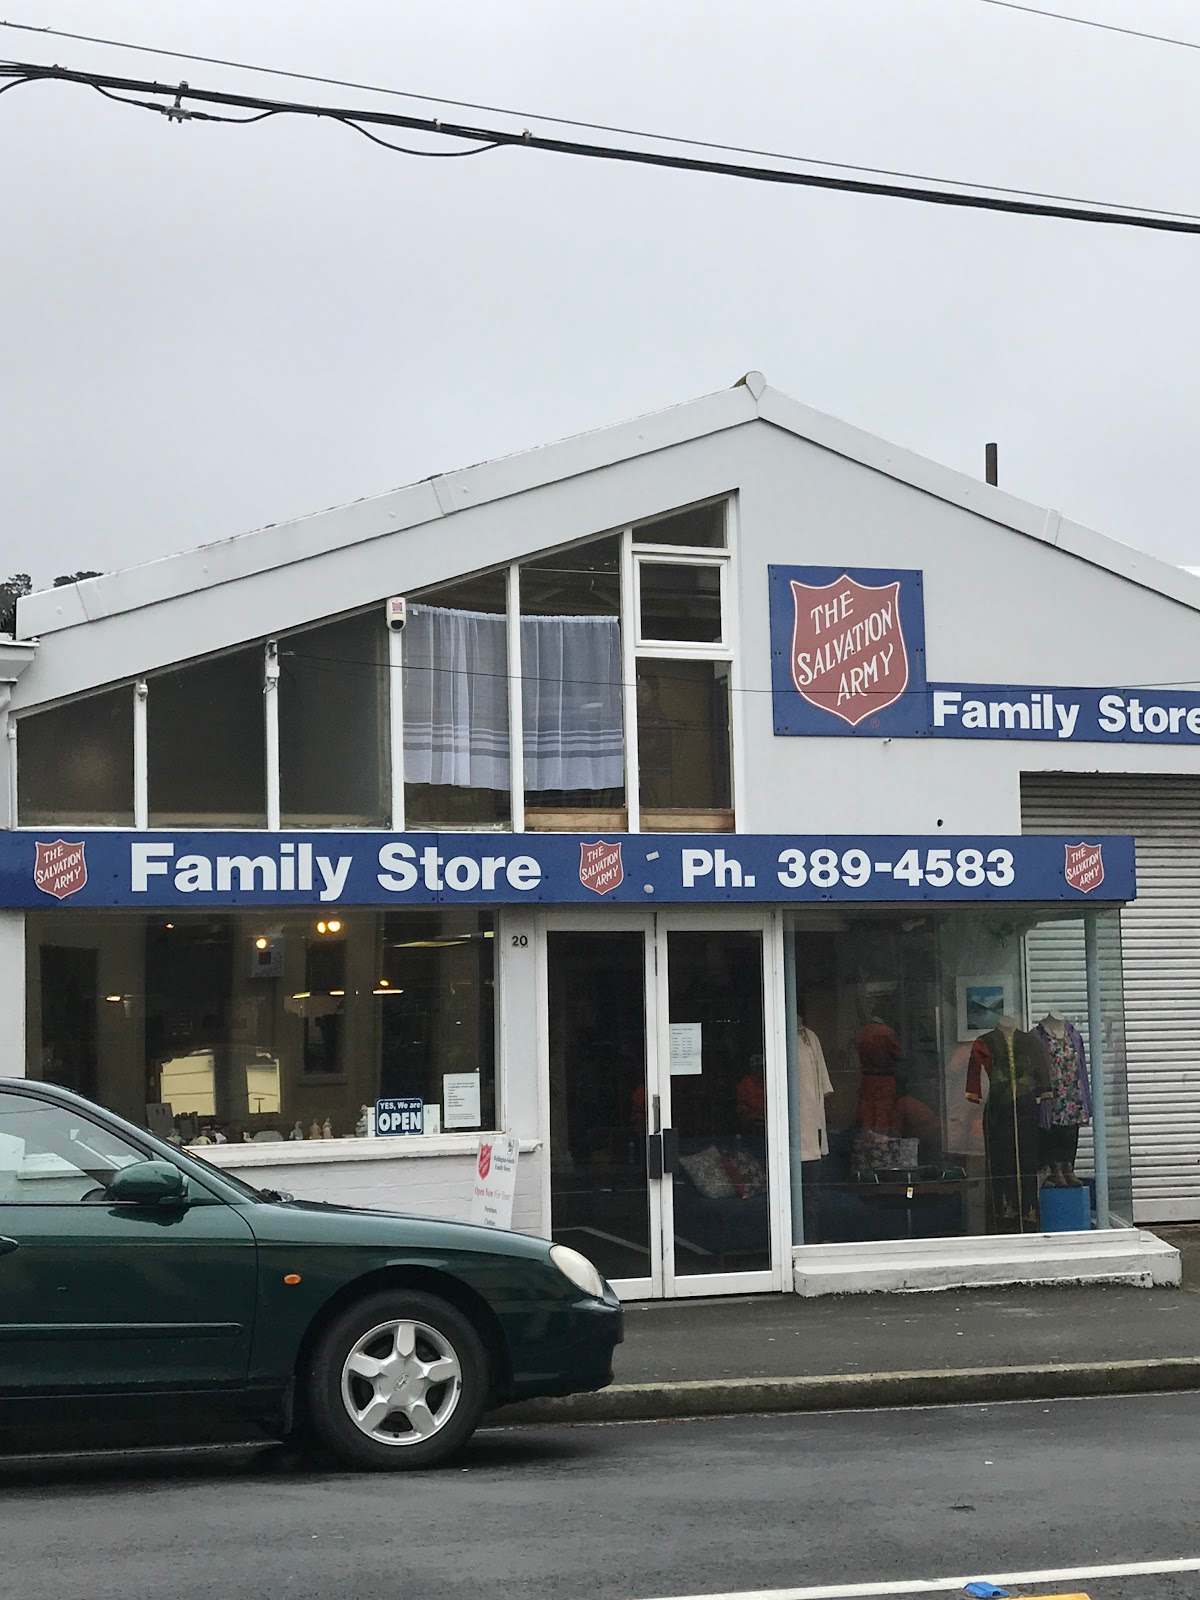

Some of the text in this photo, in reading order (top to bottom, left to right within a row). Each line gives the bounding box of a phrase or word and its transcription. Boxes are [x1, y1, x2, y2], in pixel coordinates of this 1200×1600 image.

[811, 590, 854, 635] THE
[797, 600, 893, 686] SALVATION
[837, 643, 894, 706] ARMY
[933, 692, 1080, 738] Family
[36, 848, 82, 885] SALVATION
[43, 845, 64, 864] THE
[581, 849, 619, 881] SALVATION
[586, 845, 605, 863] THE
[681, 848, 1015, 888] Ph. 389-4583
[1066, 850, 1099, 881] SALVATION
[1071, 846, 1087, 864] THE
[53, 866, 82, 892] ARMY
[131, 842, 542, 902] Family Store
[595, 864, 619, 889] ARMY
[1079, 864, 1099, 887] ARMY
[511, 935, 528, 946] 20
[380, 1100, 420, 1111] YES, We are
[378, 1111, 422, 1132] OPEN
